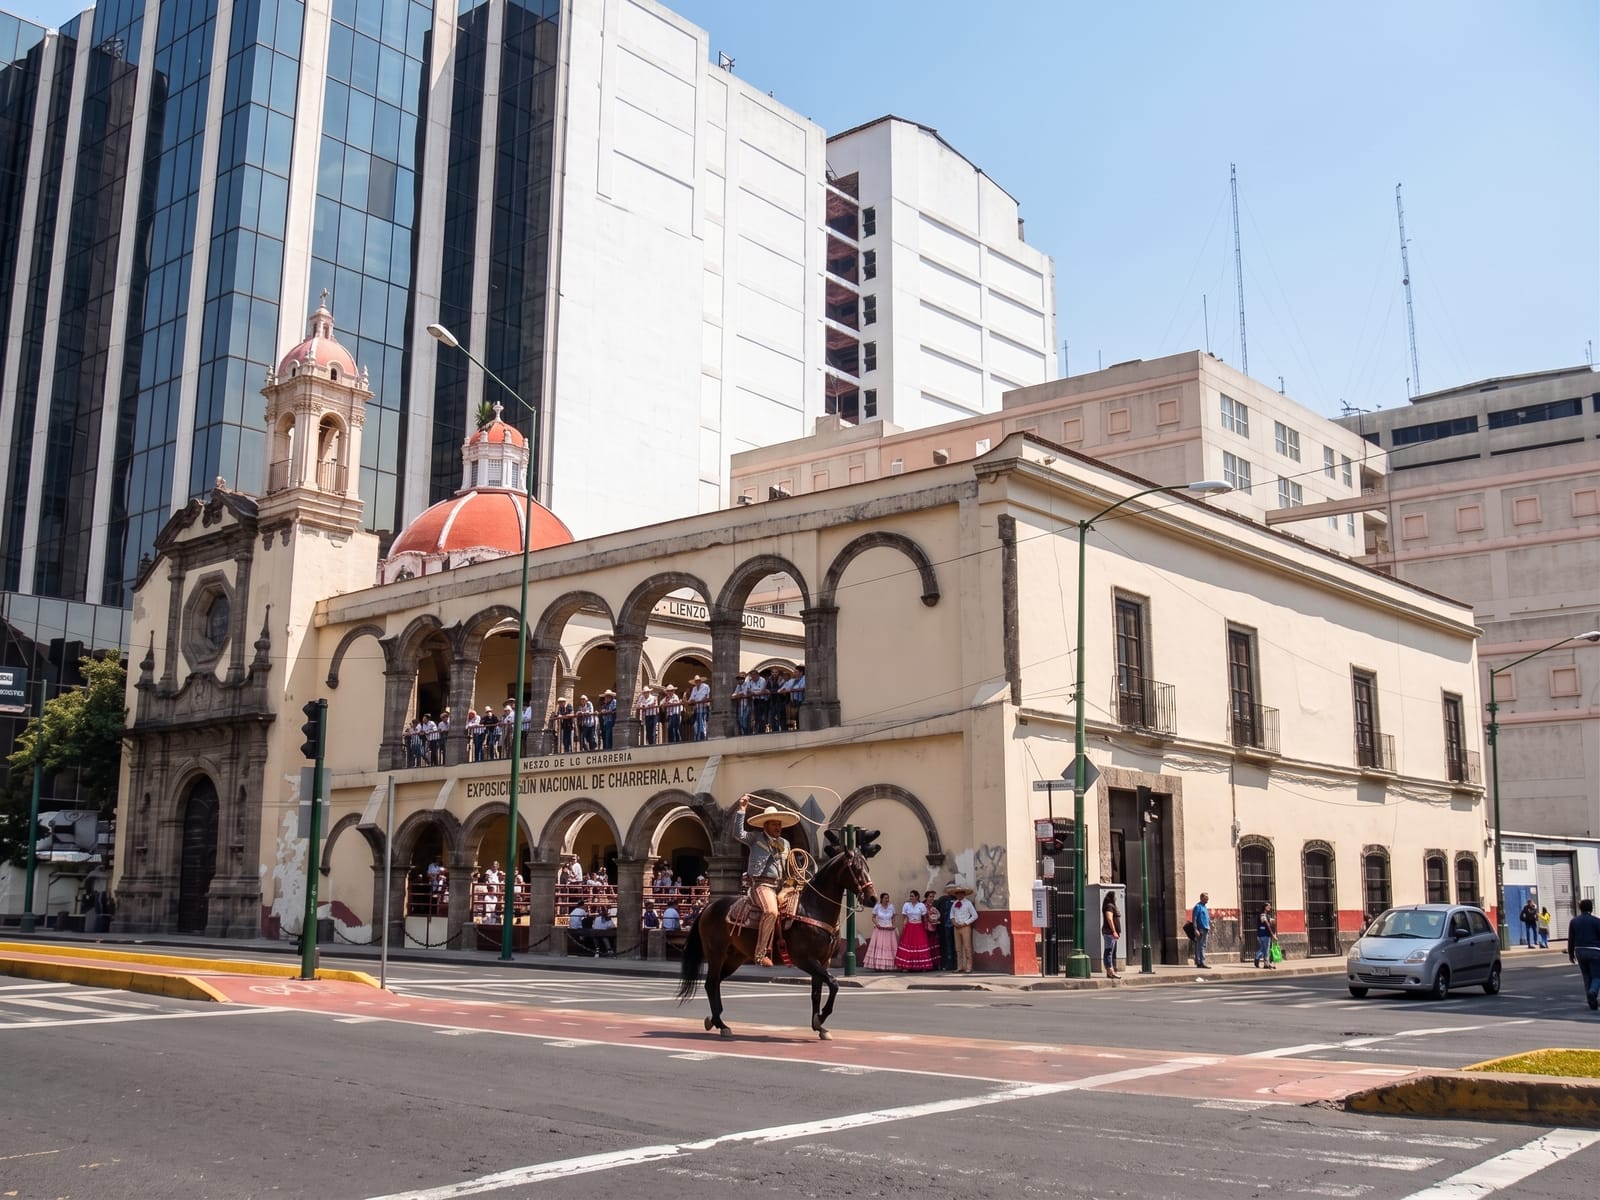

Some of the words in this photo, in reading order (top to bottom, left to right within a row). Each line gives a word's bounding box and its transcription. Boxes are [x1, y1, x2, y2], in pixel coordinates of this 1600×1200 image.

[669, 602, 706, 619] LIENZO
[554, 758, 565, 768] DE
[586, 752, 633, 765] CHARRERIA
[539, 774, 589, 793] NACIONAL
[592, 773, 605, 790] DE
[673, 767, 684, 784] A.
[686, 766, 697, 782] C.
